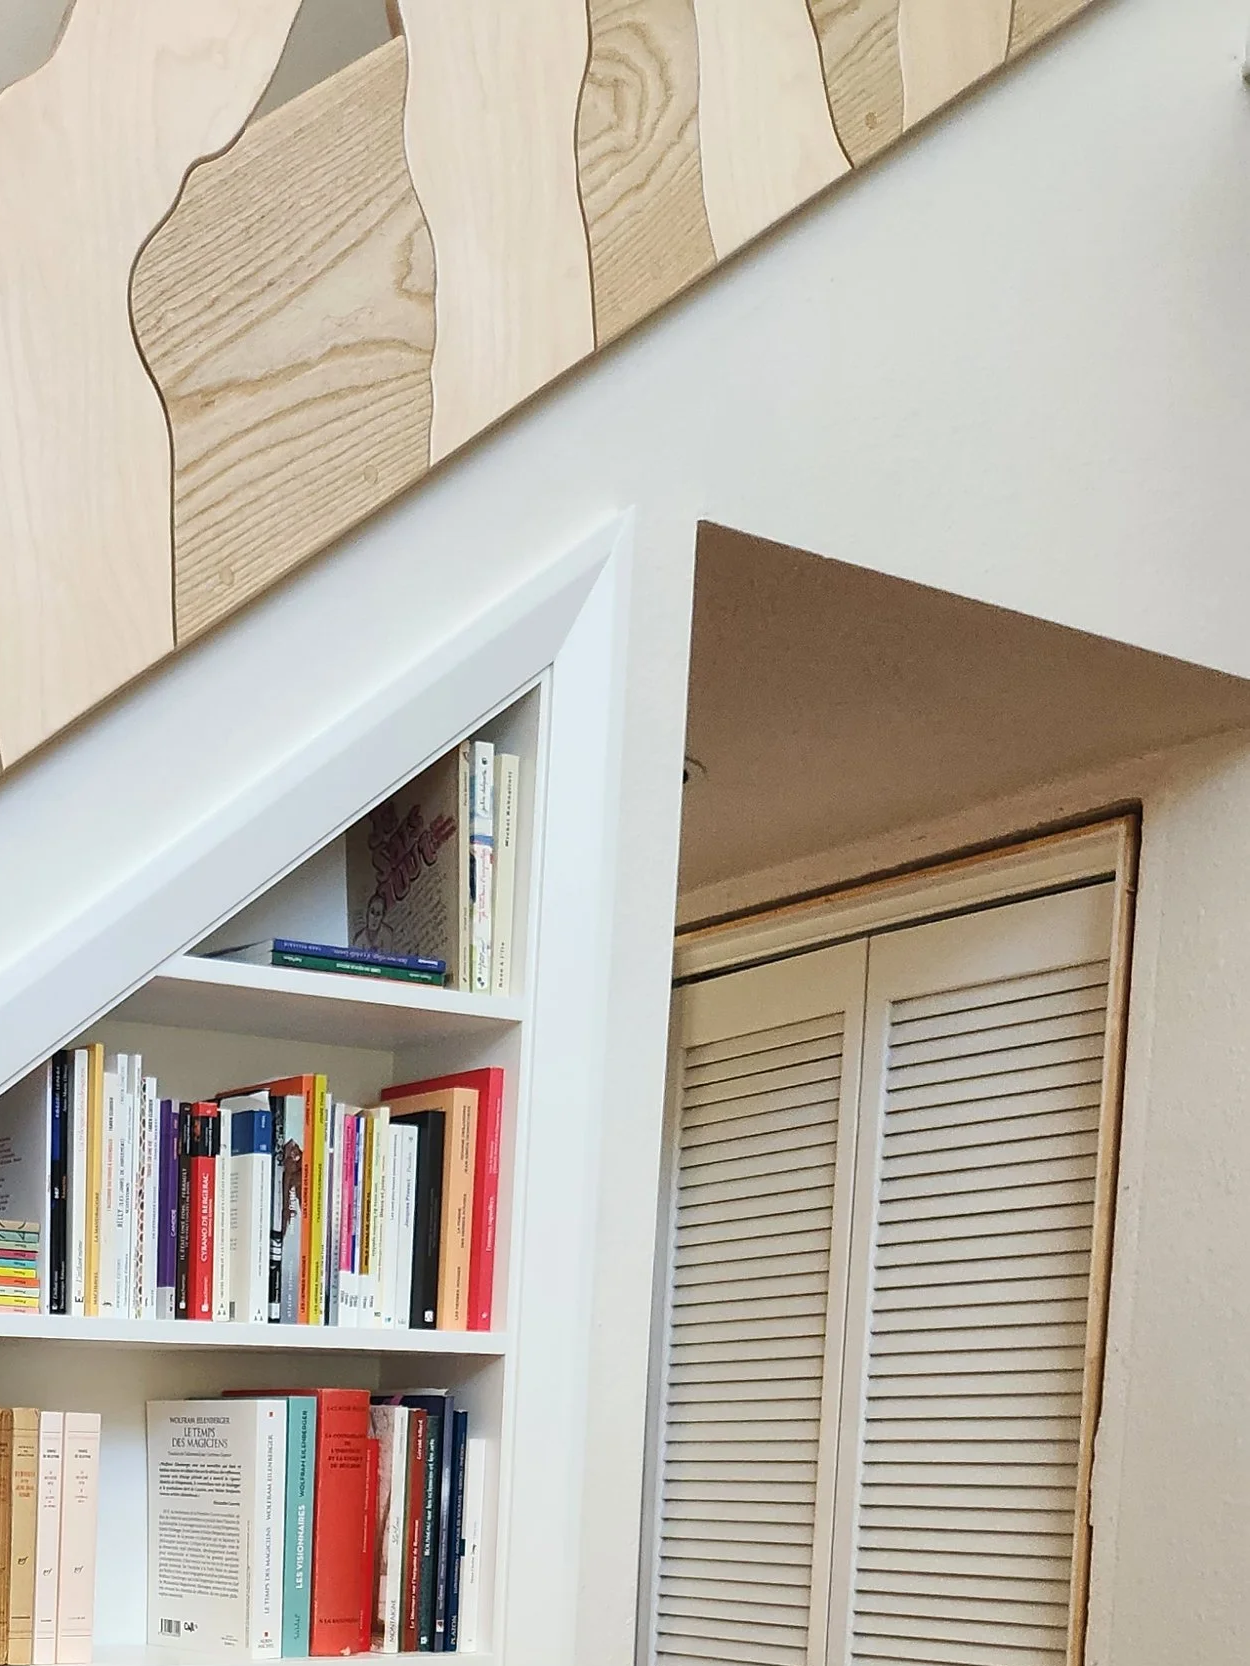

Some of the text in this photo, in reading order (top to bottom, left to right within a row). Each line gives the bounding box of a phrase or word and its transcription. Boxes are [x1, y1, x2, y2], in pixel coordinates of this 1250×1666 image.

[201, 1172, 209, 1213] BERGERAC
[200, 1227, 209, 1262] CYRANO
[171, 1437, 228, 1449] DES MAGICIENS
[193, 1427, 216, 1438] TEMPS
[298, 1410, 308, 1498] WOLFRAM EILENBERGER
[264, 1526, 272, 1567] MAGICIENS
[295, 1504, 306, 1589] LES VISIONNAIRES
[388, 1599, 397, 1643] MONTAIGNE
[449, 1615, 458, 1645] PLATON
